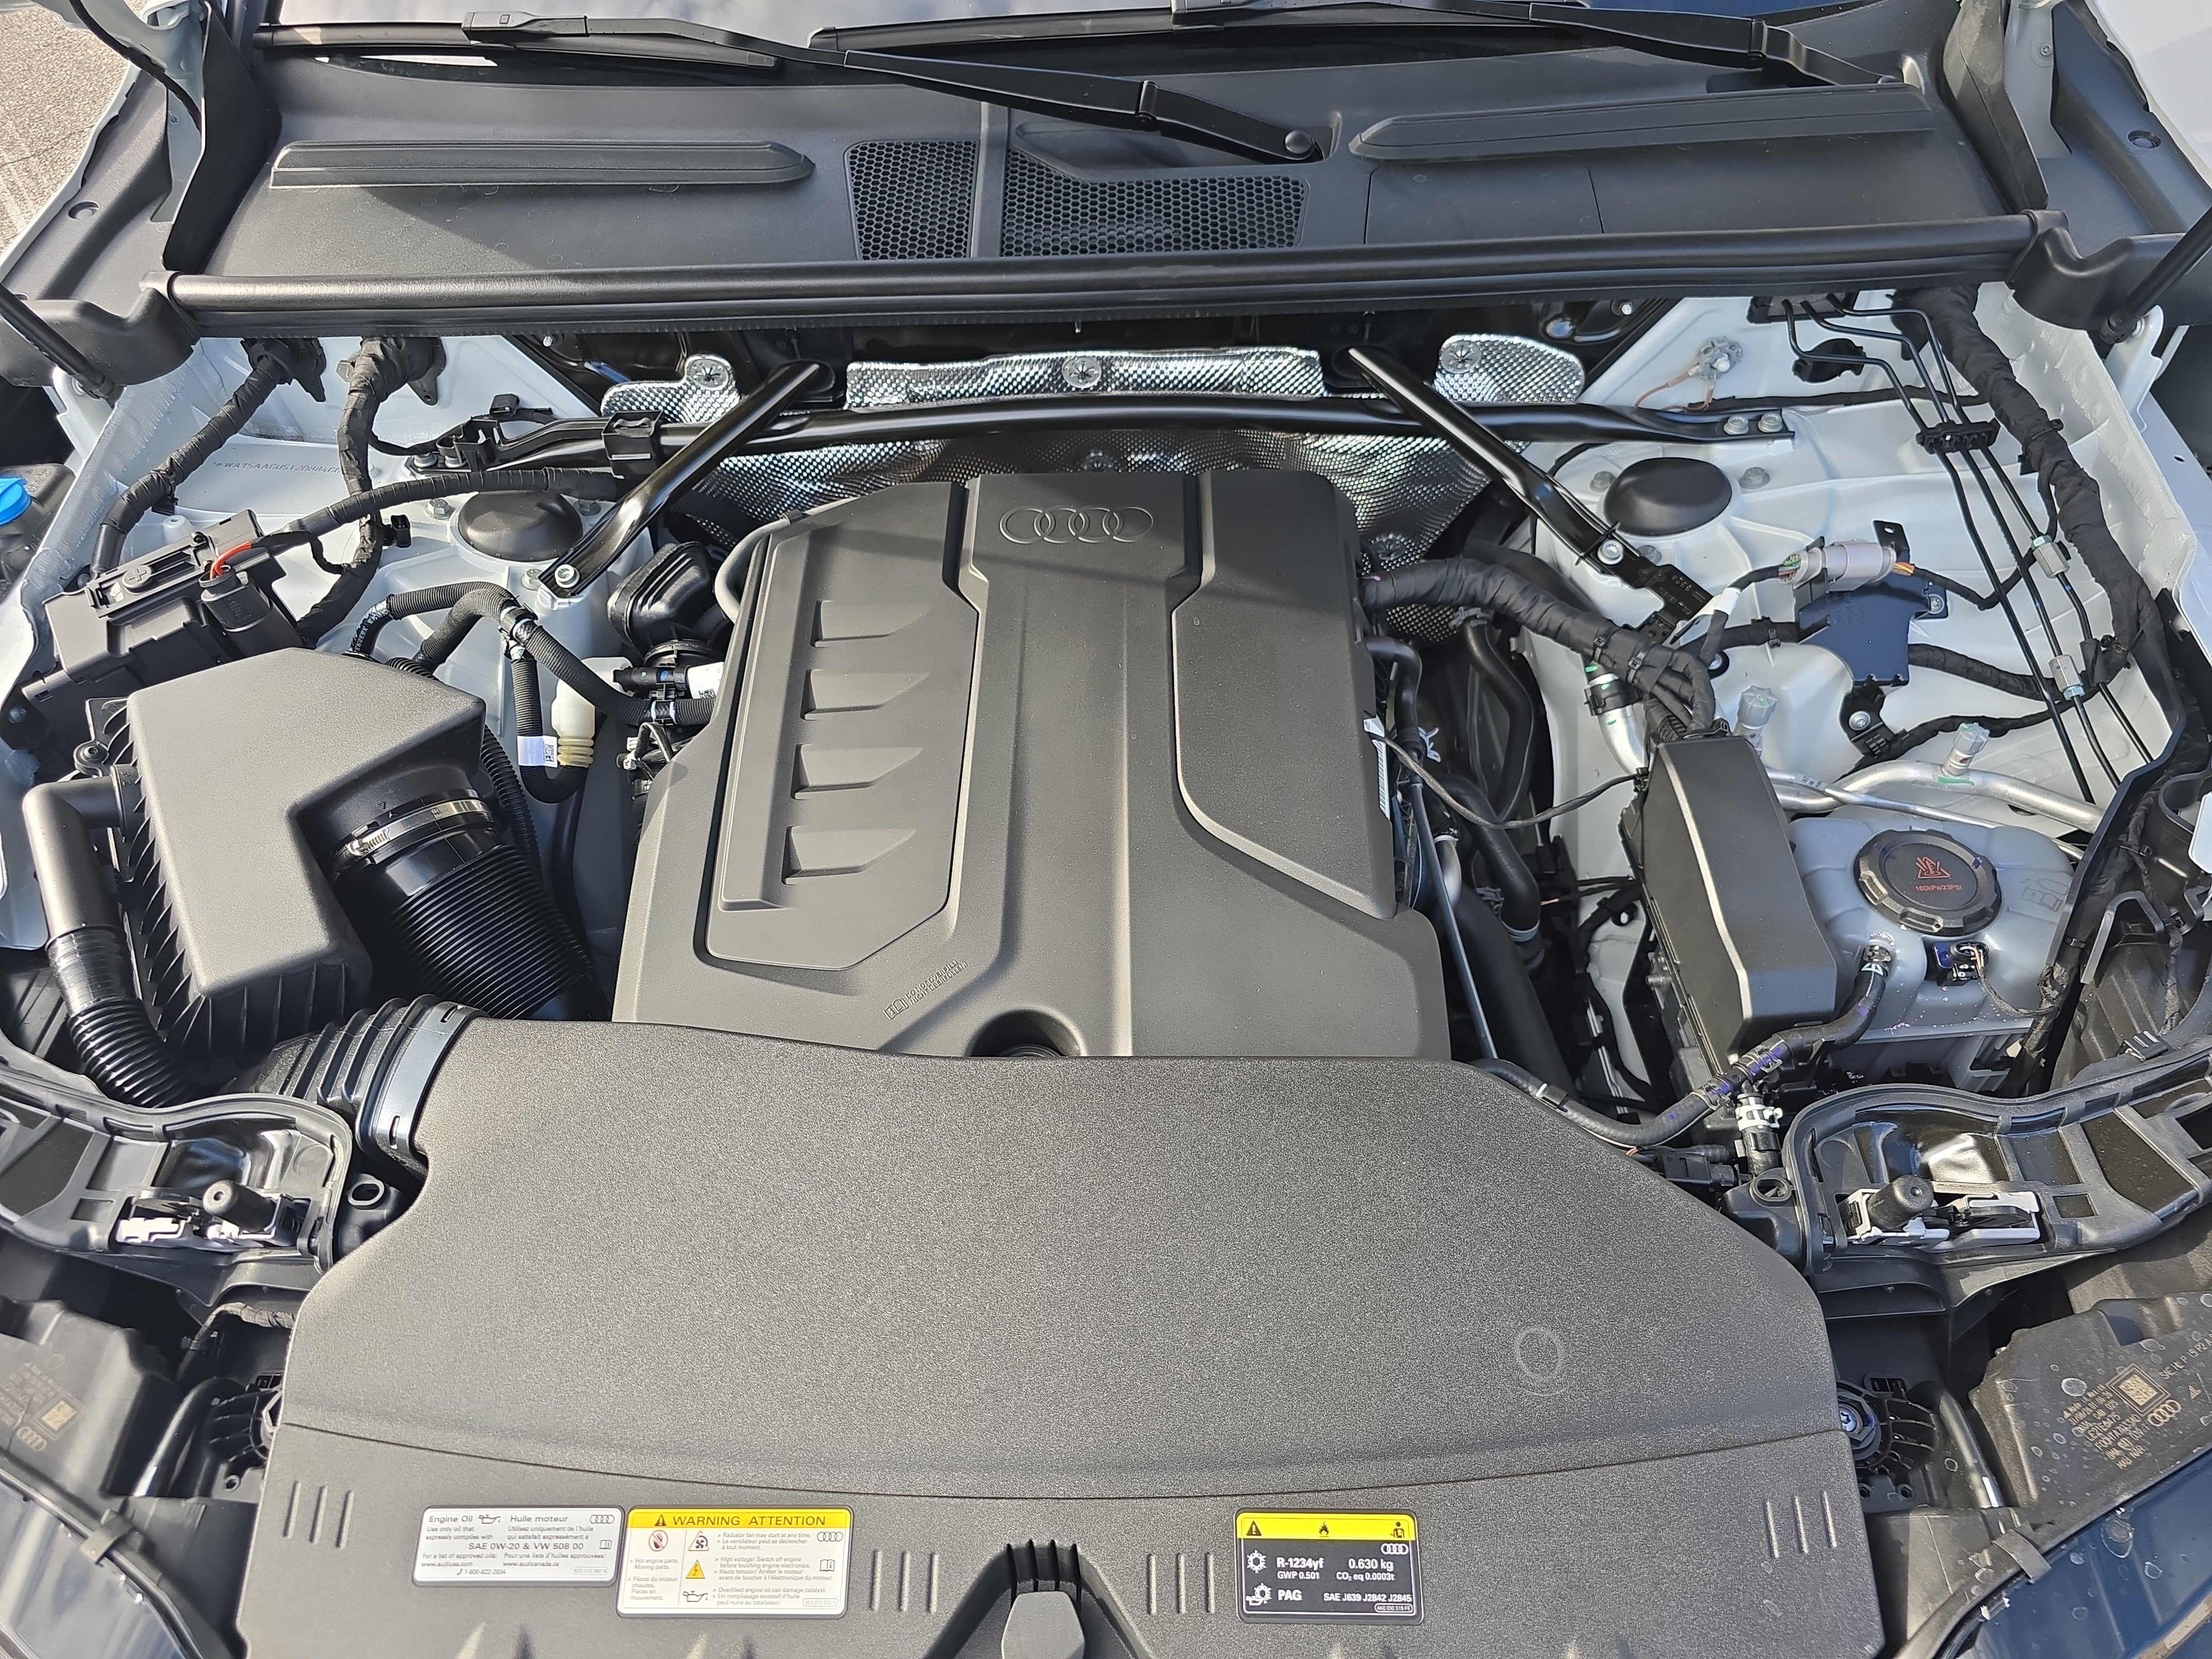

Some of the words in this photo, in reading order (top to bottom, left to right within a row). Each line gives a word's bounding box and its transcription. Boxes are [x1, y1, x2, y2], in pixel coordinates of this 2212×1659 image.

[429, 1515, 458, 1523] Engine
[673, 1516, 740, 1525] WARNING
[748, 1516, 826, 1525] ATTENTION
[1276, 1557, 1324, 1571] R-1234yf
[1348, 1558, 1378, 1569] 0.630
[1380, 1559, 1394, 1571] kg
[1277, 1571, 1298, 1579] GWP
[1298, 1571, 1320, 1579] 0.501
[1353, 1573, 1364, 1581] eq
[1365, 1572, 1396, 1580] 0.0003t
[1277, 1589, 1302, 1600] PAG
[1323, 1593, 1342, 1601] SAE
[1342, 1593, 1362, 1602] J639
[1362, 1593, 1387, 1602] J2842
[1388, 1594, 1412, 1602] J2845
